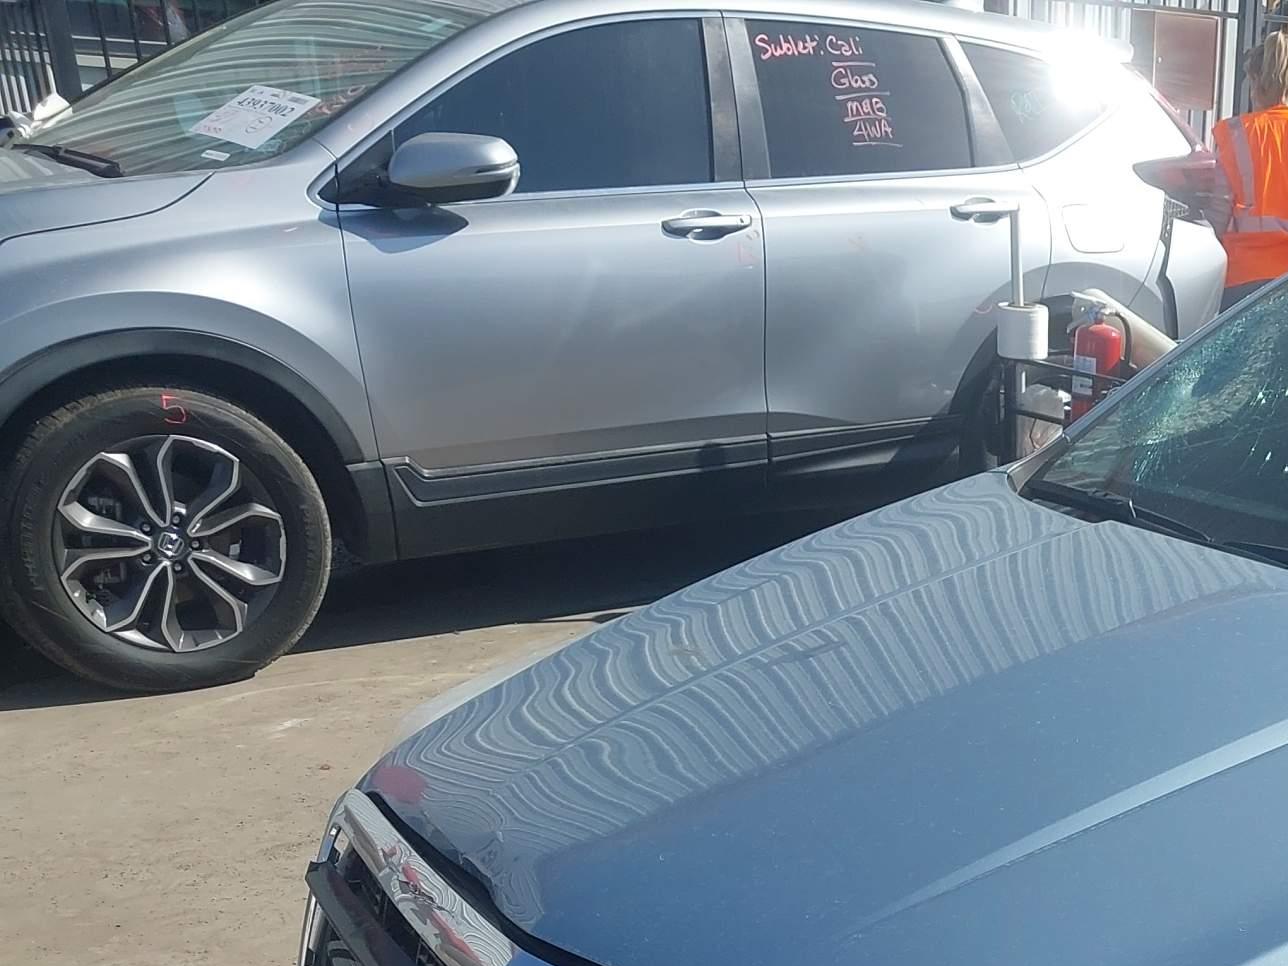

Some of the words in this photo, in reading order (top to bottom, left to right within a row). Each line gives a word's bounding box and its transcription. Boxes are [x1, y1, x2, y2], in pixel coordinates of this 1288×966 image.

[826, 35, 864, 56] Cali
[831, 67, 879, 89] Glass
[161, 393, 187, 424] 5
